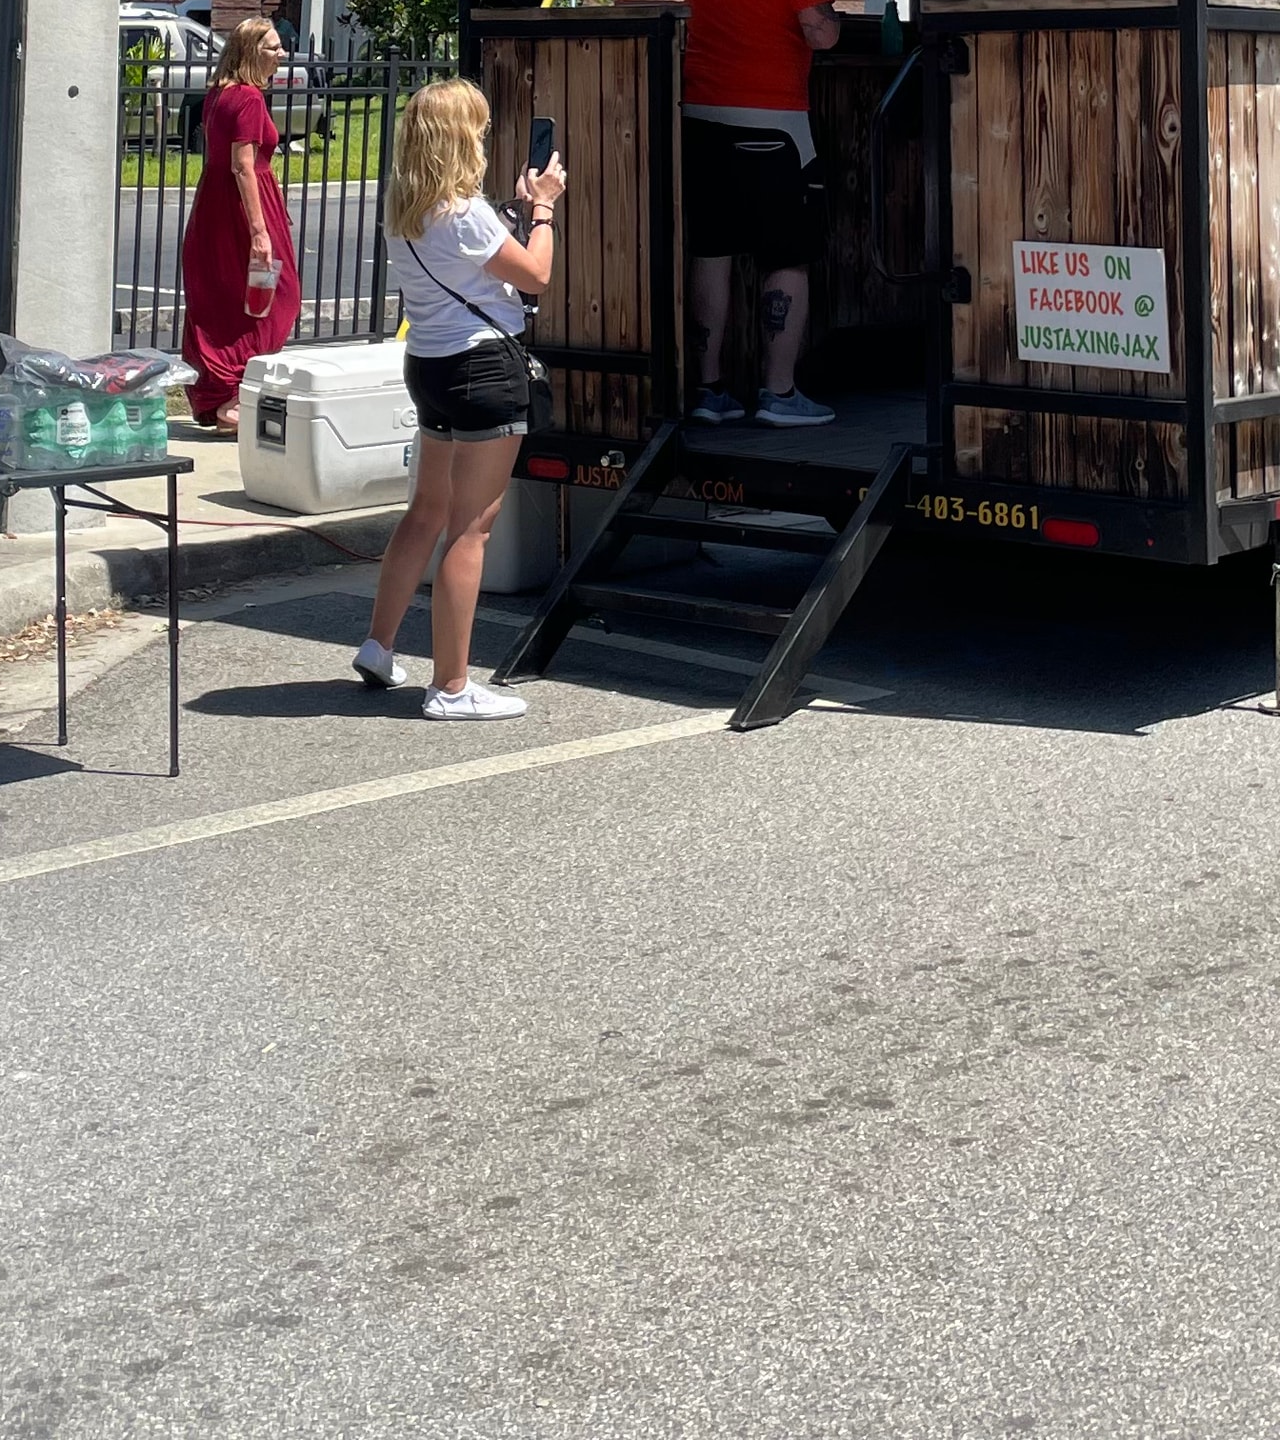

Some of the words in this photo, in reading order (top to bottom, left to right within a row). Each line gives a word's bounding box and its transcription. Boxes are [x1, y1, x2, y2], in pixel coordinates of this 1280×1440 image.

[1021, 250, 1060, 275] LIKE
[1065, 252, 1090, 277] US
[1104, 255, 1131, 281] ON
[1029, 288, 1124, 316] FACEBOOK
[1134, 294, 1155, 317] @
[1020, 325, 1160, 361] JUSTAXINGJAX
